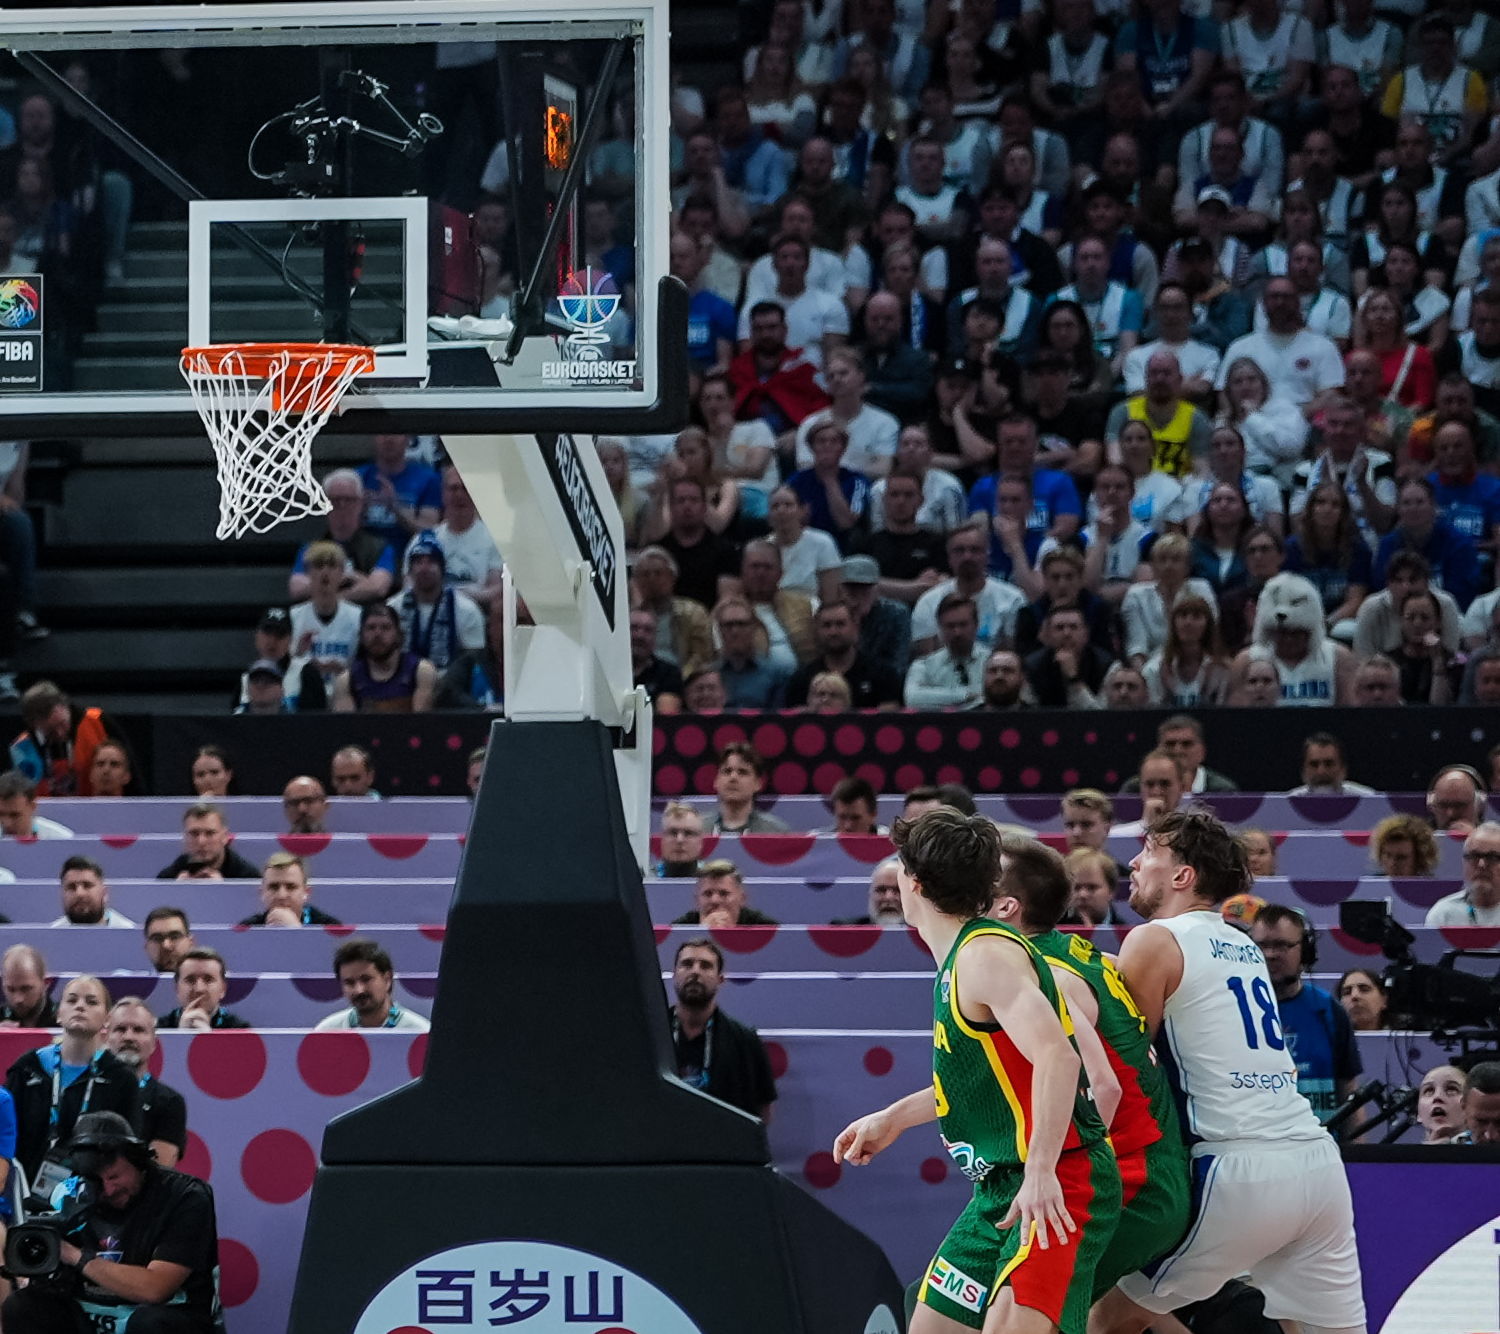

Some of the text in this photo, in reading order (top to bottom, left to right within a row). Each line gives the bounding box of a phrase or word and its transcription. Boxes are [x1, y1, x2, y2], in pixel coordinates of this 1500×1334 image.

[541, 360, 637, 379] EUROBASKET
[1227, 976, 1285, 1051] 18
[415, 1268, 625, 1327] 百岁山
